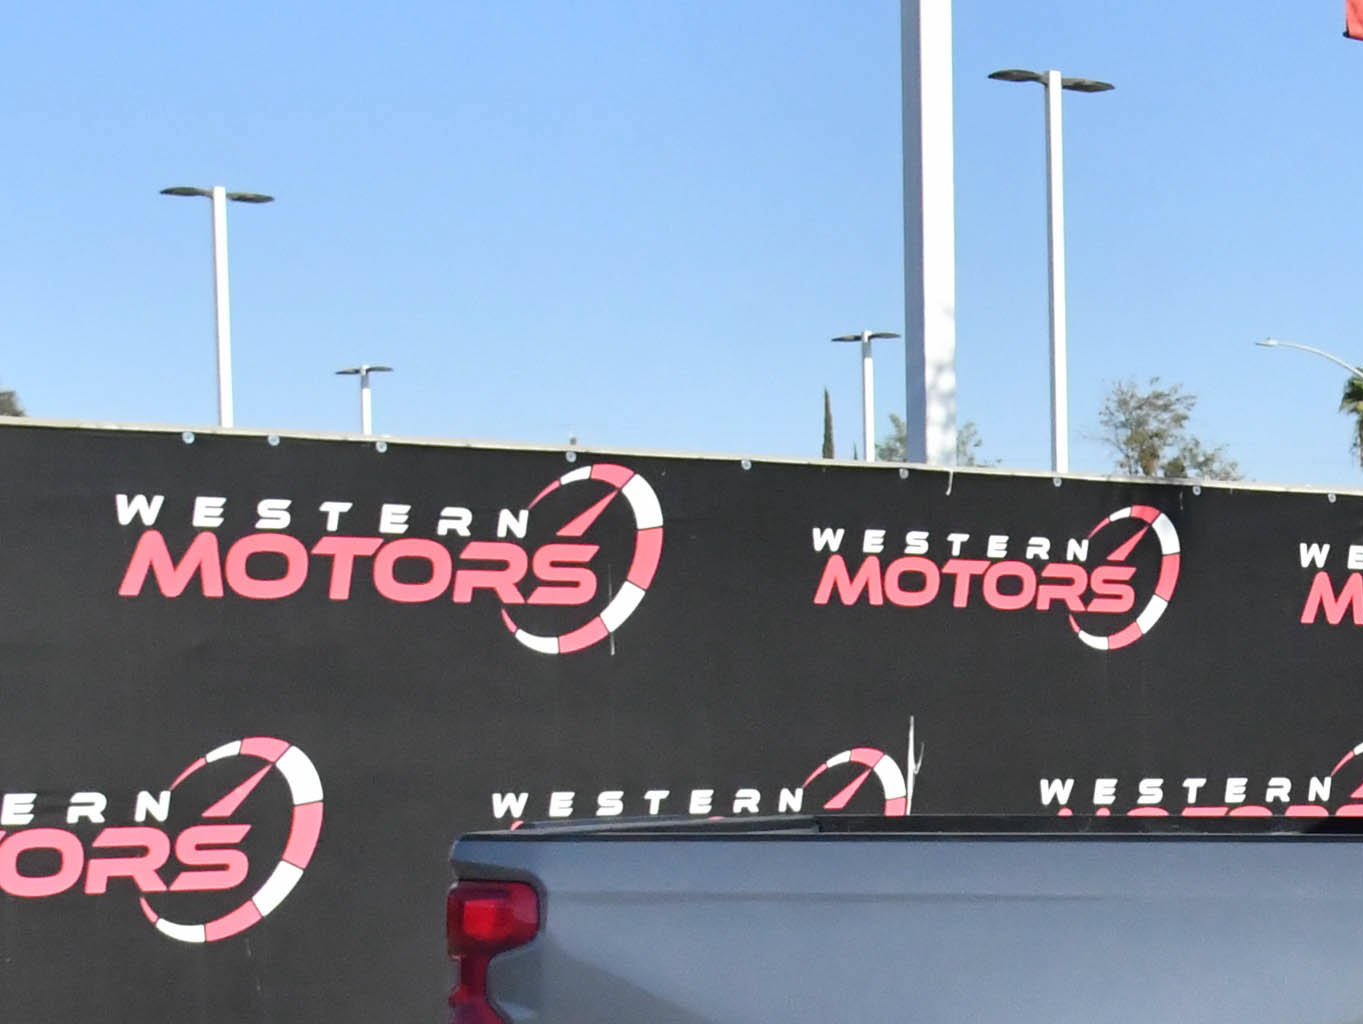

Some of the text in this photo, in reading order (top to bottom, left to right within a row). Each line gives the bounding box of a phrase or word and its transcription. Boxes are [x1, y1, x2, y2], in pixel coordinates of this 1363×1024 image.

[115, 494, 530, 539] WESTERN
[811, 527, 1090, 562] WESTERN
[117, 530, 600, 606] MOTORS
[812, 553, 1137, 614] MOTORS
[492, 787, 804, 819] WESTERN
[1039, 776, 1332, 806] WESTERN
[0, 823, 252, 898] ORS
